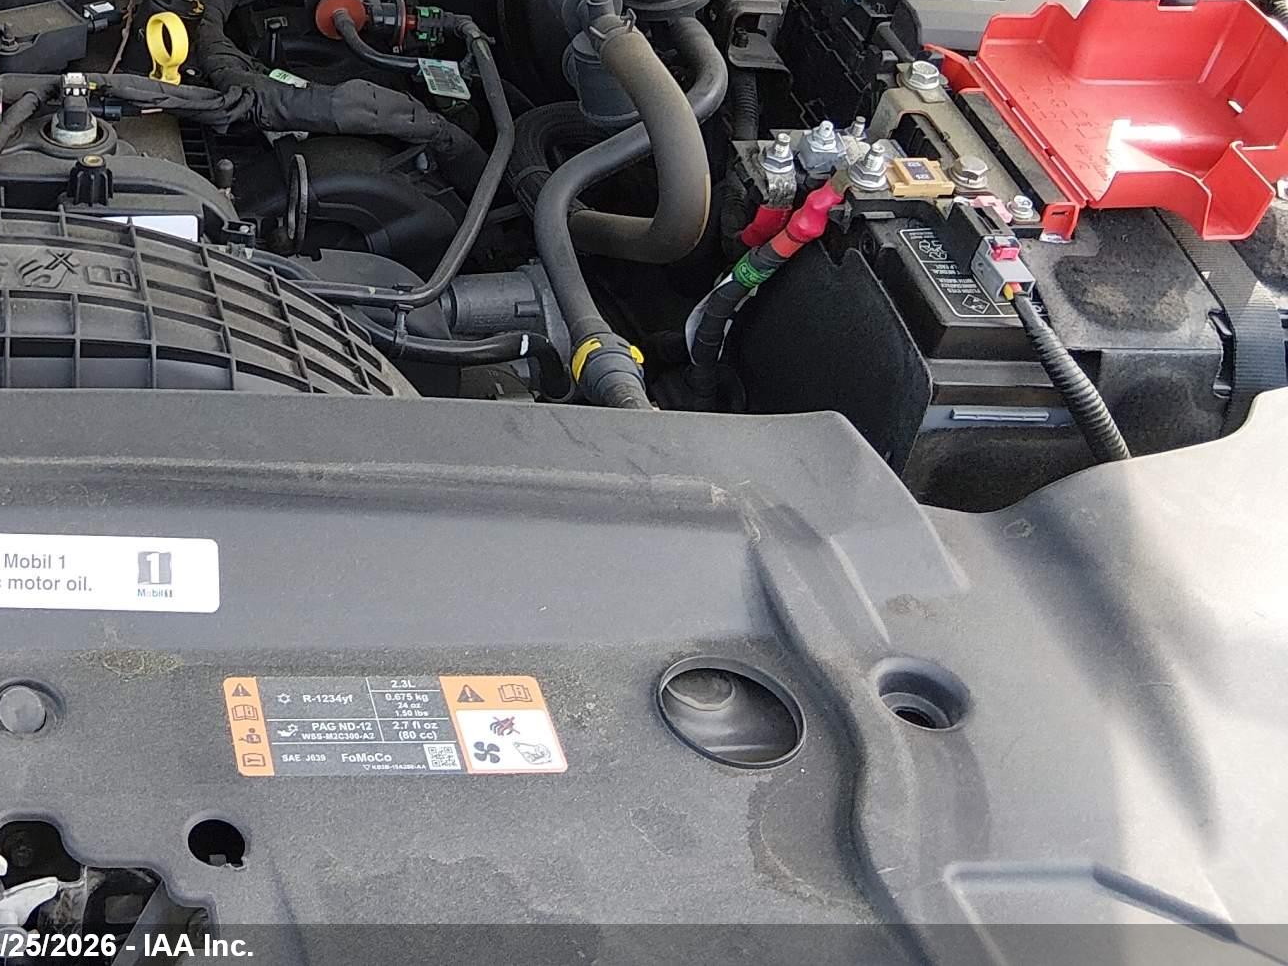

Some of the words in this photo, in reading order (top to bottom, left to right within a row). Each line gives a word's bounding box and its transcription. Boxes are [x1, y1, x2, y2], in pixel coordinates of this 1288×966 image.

[4, 553, 52, 569] Mobil
[59, 554, 66, 569] 1
[8, 577, 60, 591] motor
[66, 576, 93, 591] oil.
[390, 679, 416, 688] 2.3L
[303, 694, 353, 705] R-1234yf
[385, 693, 413, 701] 0.675
[415, 693, 429, 703] kg
[414, 709, 429, 717] lbs
[311, 722, 336, 731] PAG
[339, 721, 373, 731] ND-12
[391, 721, 409, 729] 2.7
[412, 720, 421, 729] fl
[423, 722, 439, 730] oz
[398, 730, 417, 741] (80
[419, 730, 438, 741] cc)
[282, 754, 302, 762] SAE
[341, 753, 392, 763] FoMoCo
